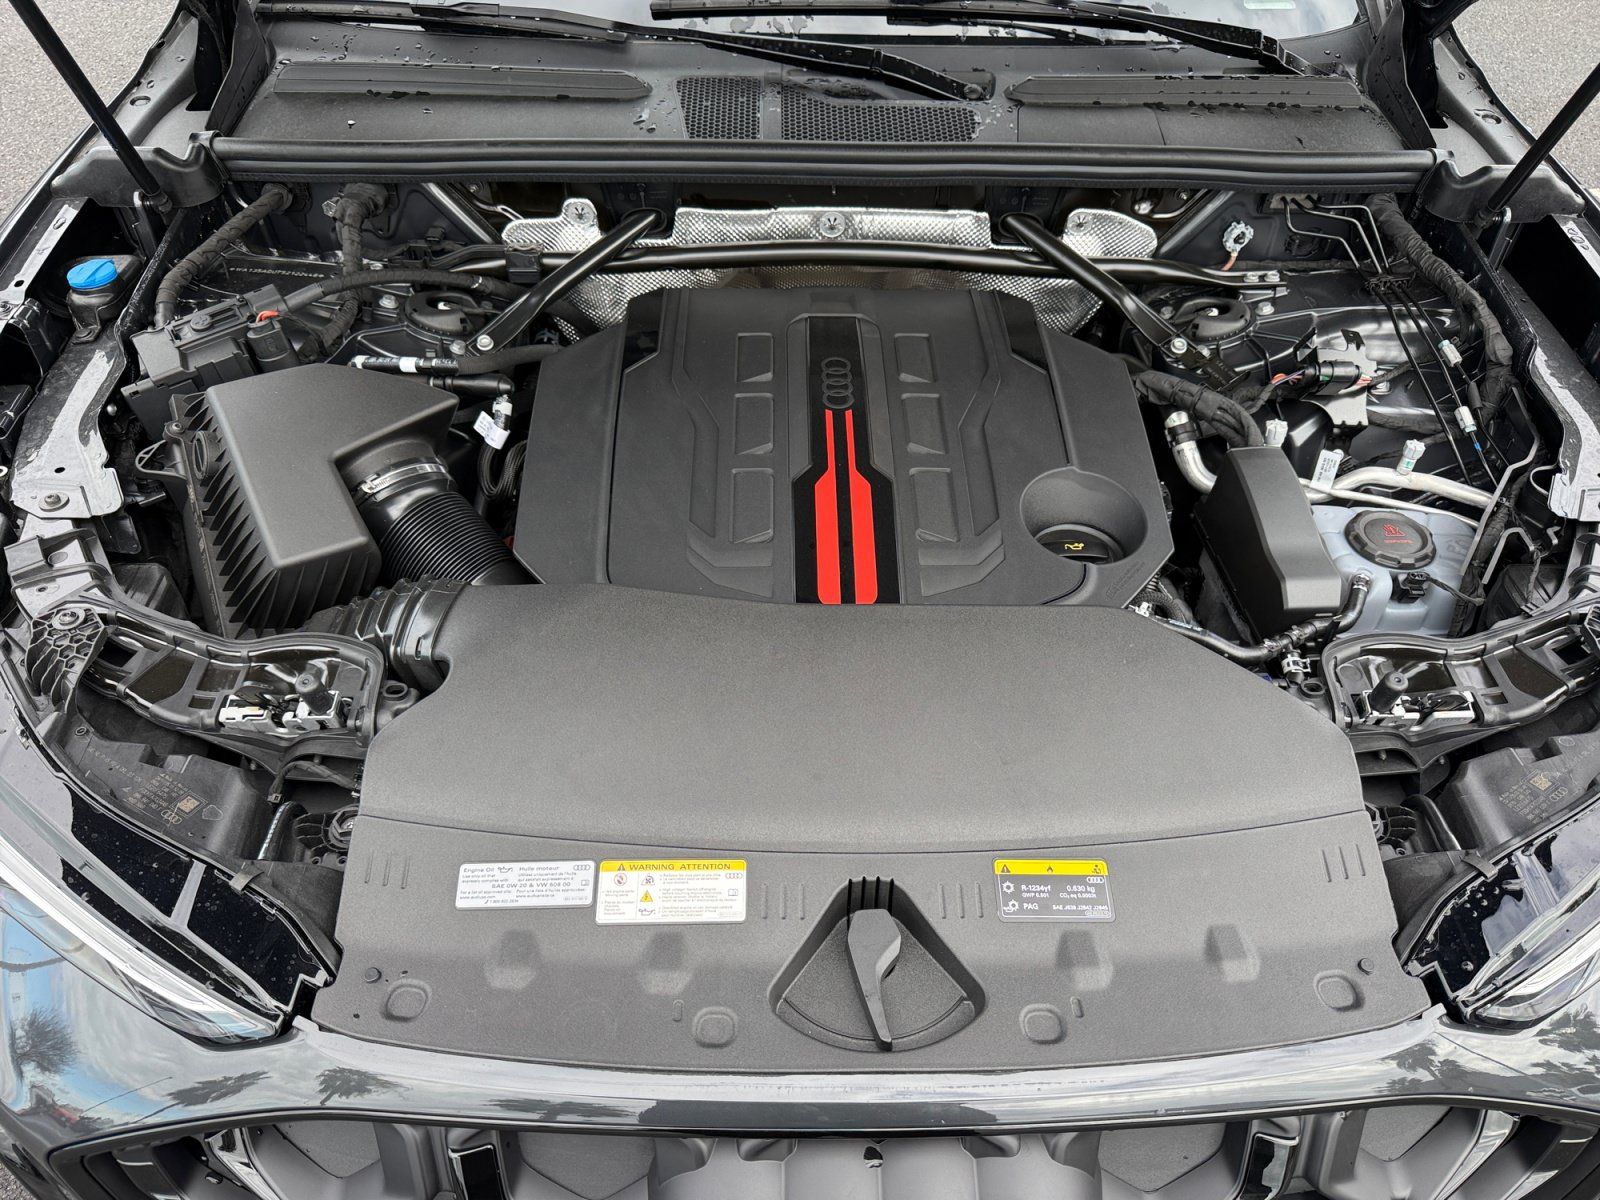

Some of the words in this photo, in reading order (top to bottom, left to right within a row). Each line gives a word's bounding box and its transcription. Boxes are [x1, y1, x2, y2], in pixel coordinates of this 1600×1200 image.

[629, 863, 675, 871] WARNING
[1021, 884, 1051, 893] R-1234yf
[1086, 885, 1096, 893] kg
[1023, 902, 1039, 910] PAG
